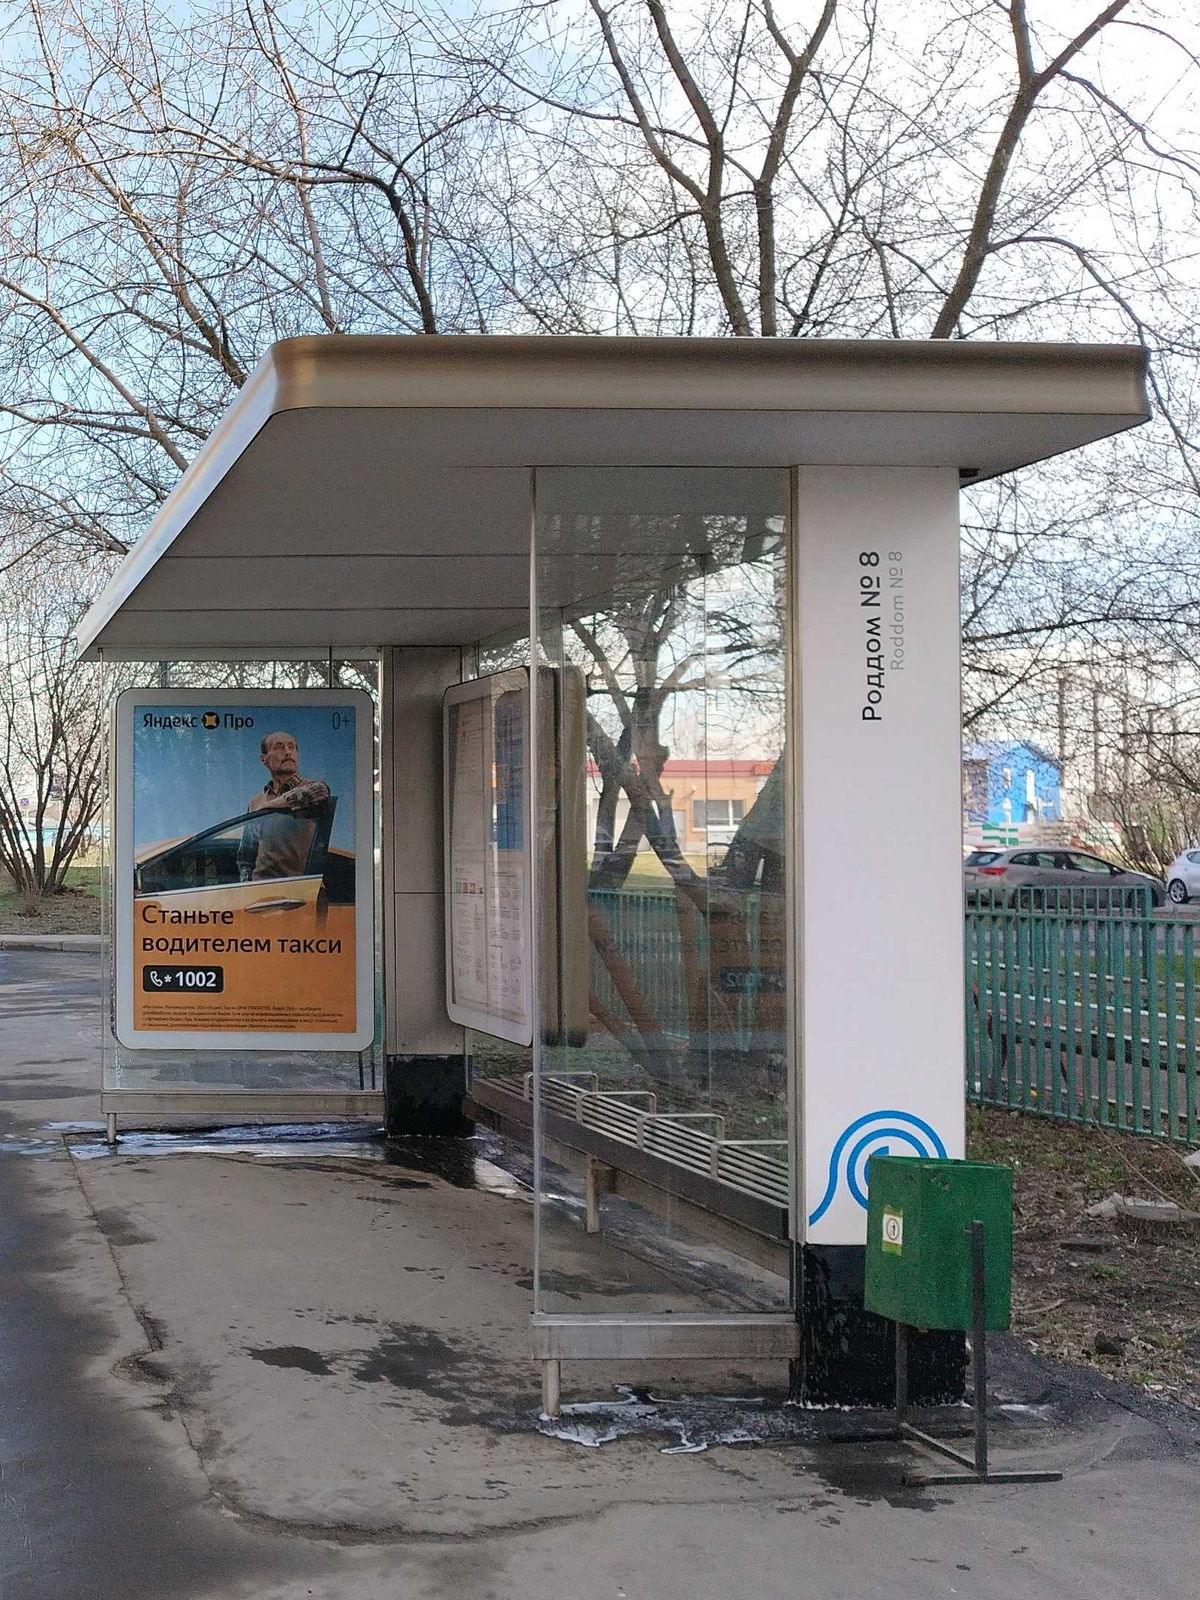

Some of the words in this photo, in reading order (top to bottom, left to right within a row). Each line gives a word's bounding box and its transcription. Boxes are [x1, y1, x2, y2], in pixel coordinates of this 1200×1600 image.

[859, 551, 880, 567] 8
[888, 551, 902, 561] 8
[889, 567, 903, 588] №
[860, 575, 881, 607] №
[889, 595, 904, 670] Roddom
[862, 617, 884, 720] Роддом
[143, 713, 198, 730] Яндекс
[224, 714, 254, 730] Про
[332, 712, 349, 730] 0+
[142, 905, 234, 925] Станьте
[142, 937, 271, 955] водителем
[277, 938, 342, 954] такси
